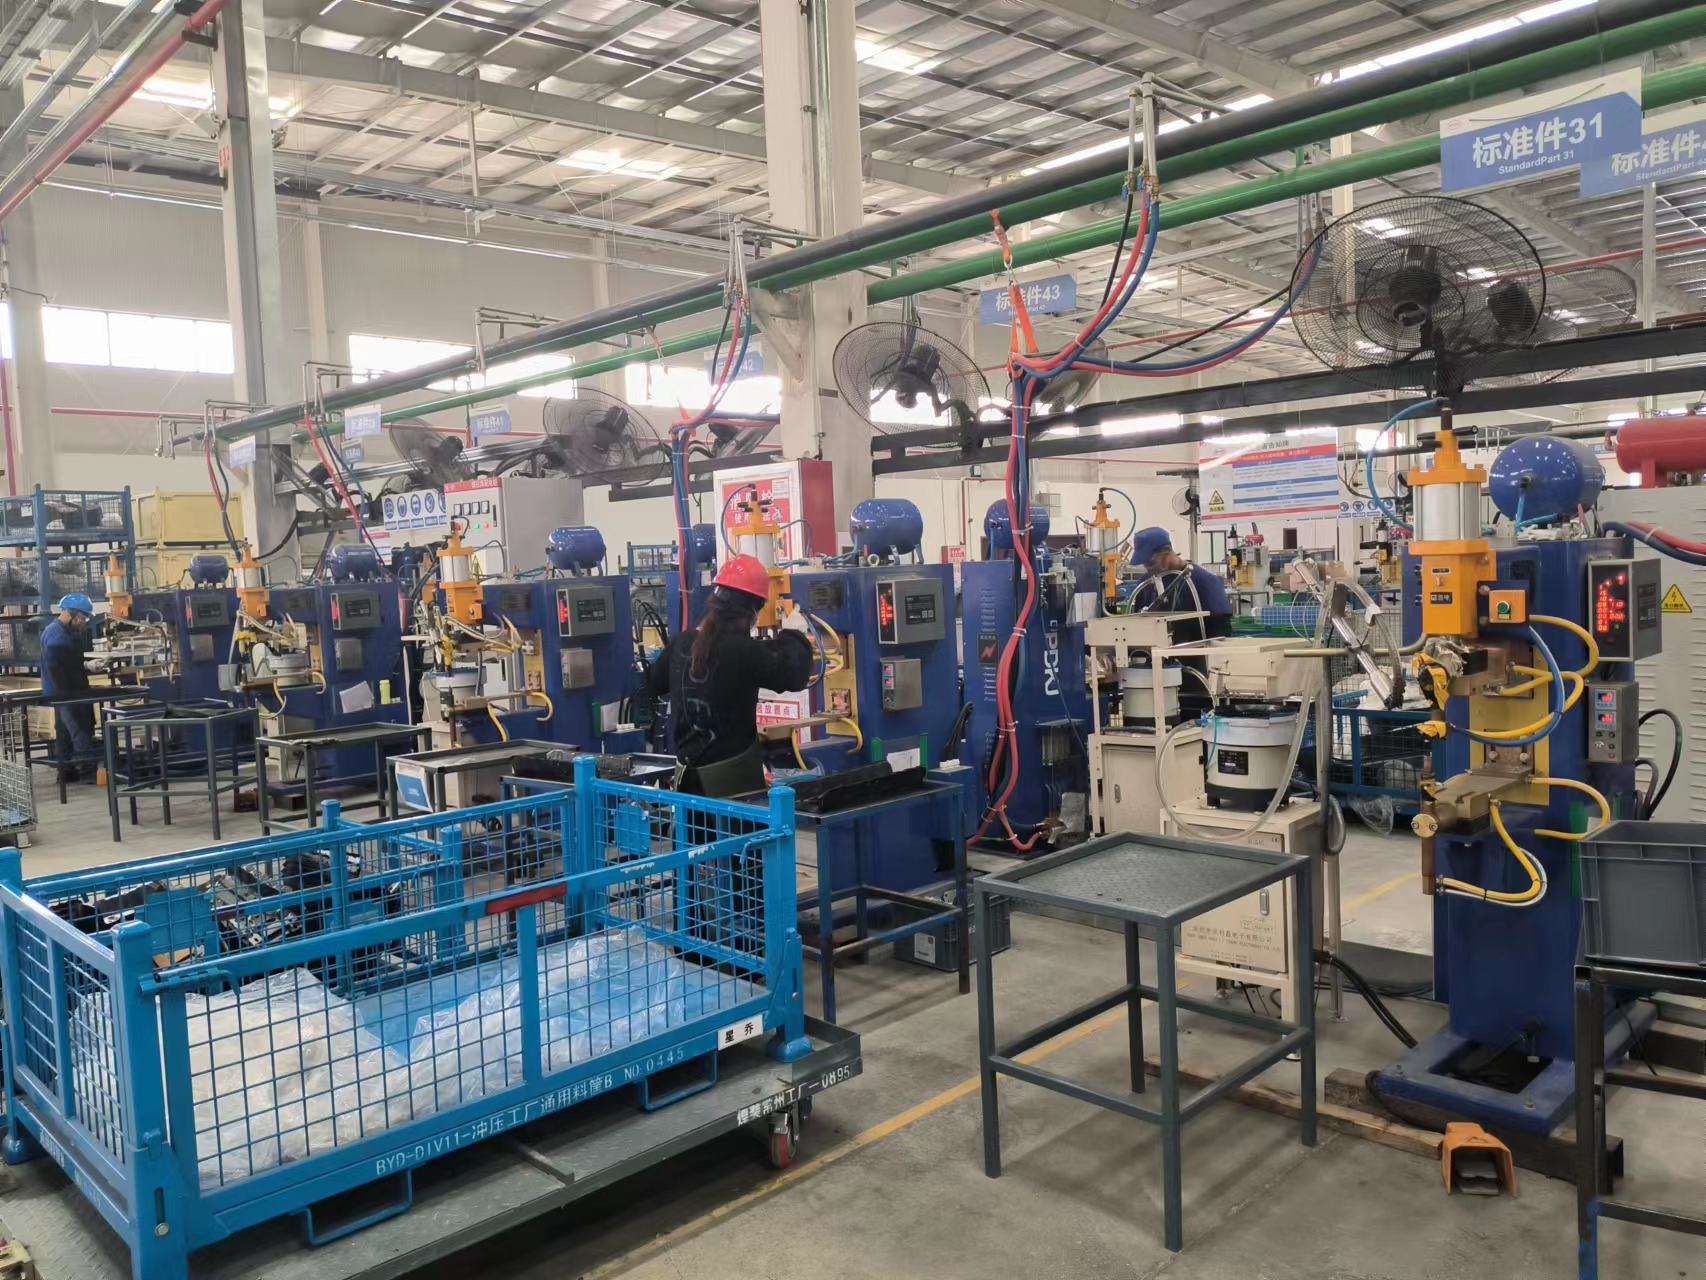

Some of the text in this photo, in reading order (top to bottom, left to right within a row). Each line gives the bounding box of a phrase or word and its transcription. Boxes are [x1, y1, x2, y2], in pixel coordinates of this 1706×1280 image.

[1472, 111, 1604, 169] 标准件31
[1498, 149, 1575, 175] StandardPart 31
[996, 284, 1061, 312] 标件43
